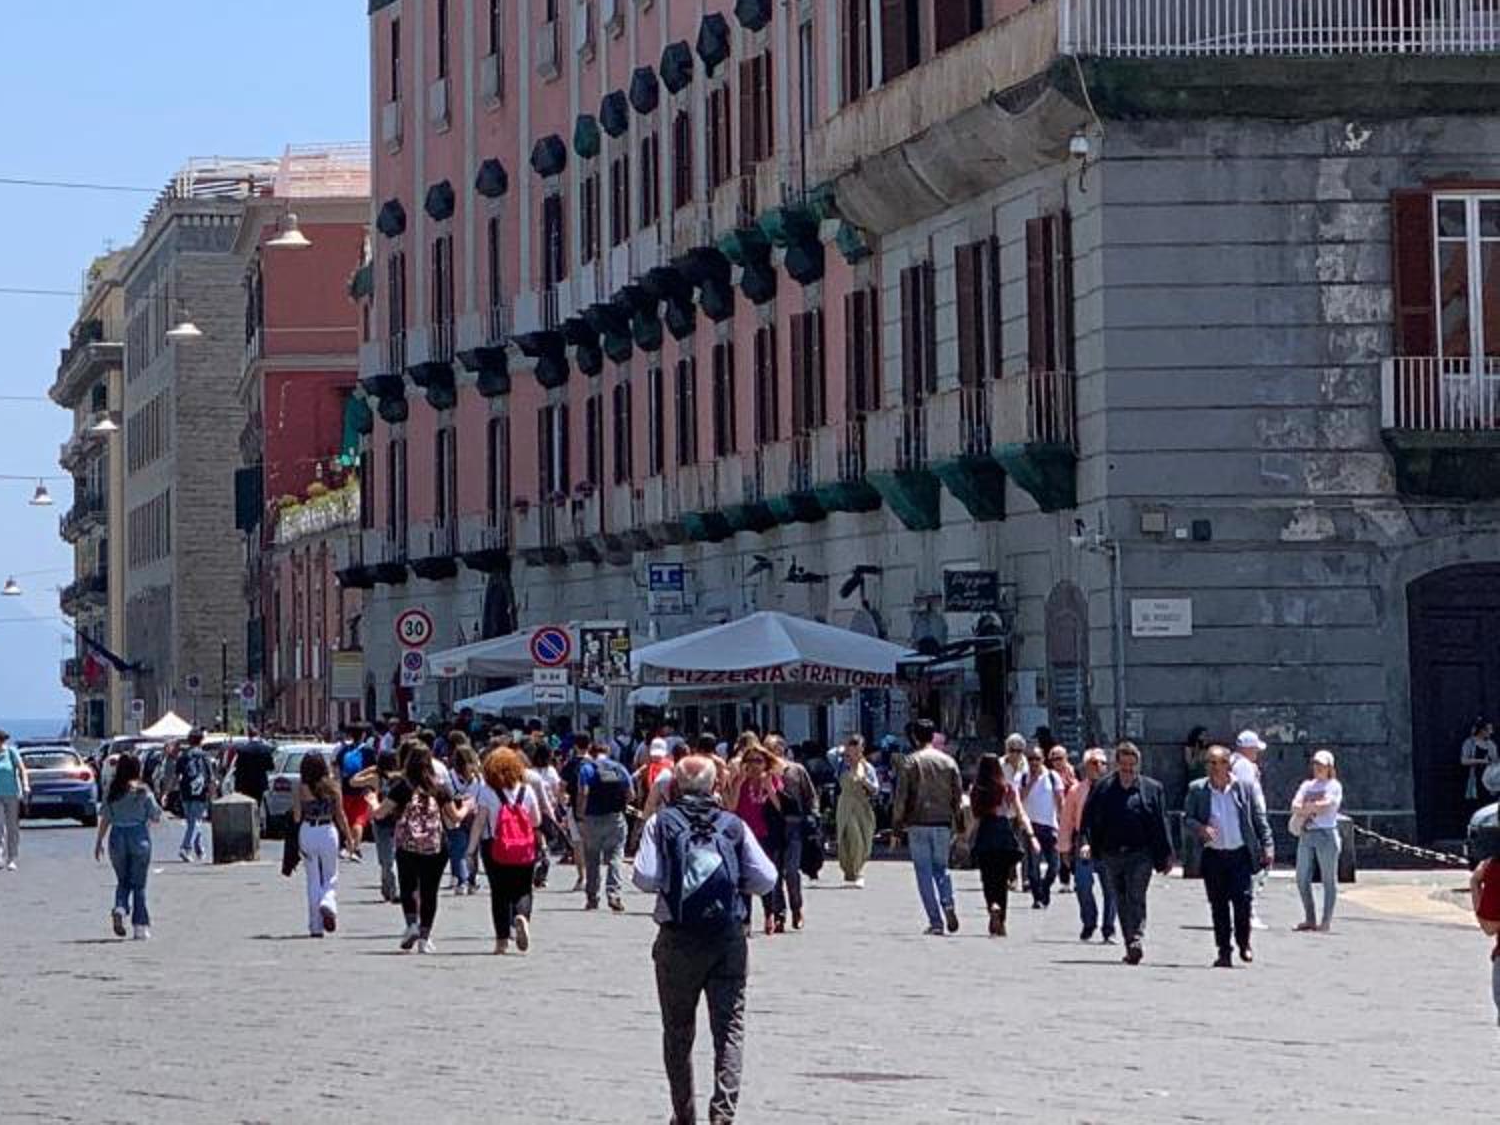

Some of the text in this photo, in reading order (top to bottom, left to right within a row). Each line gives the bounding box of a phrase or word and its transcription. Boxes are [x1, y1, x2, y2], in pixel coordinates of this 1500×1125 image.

[405, 620, 424, 636] 30
[667, 666, 786, 683] PIZZERIA
[802, 663, 894, 686] TRATTORIA
